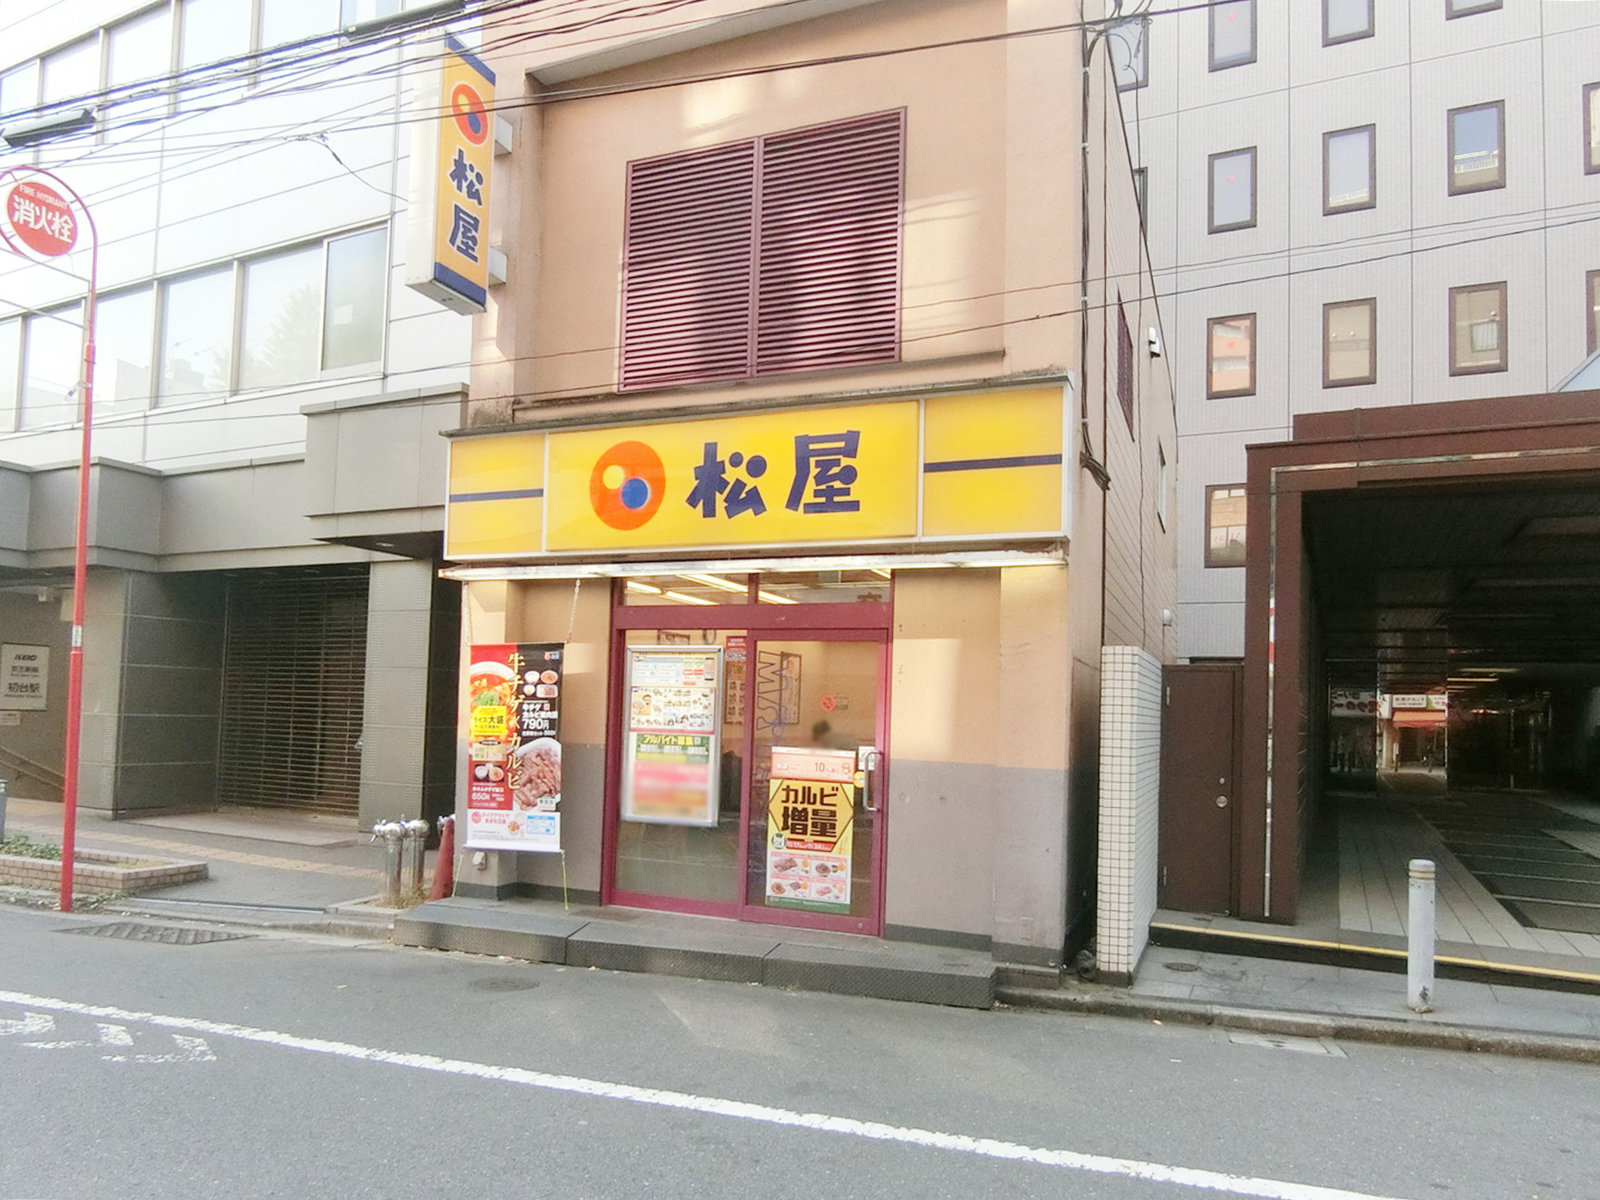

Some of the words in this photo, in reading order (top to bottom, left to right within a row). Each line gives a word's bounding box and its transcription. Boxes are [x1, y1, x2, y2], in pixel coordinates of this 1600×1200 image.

[19, 184, 35, 197] FIRE
[36, 191, 68, 210] HYDRANT
[448, 148, 484, 263] 松屋
[13, 194, 74, 244] 消火栓
[685, 430, 861, 519] 松屋
[8, 682, 40, 693] 初台駅
[781, 785, 839, 807] カルビ
[781, 806, 838, 838] 増量
